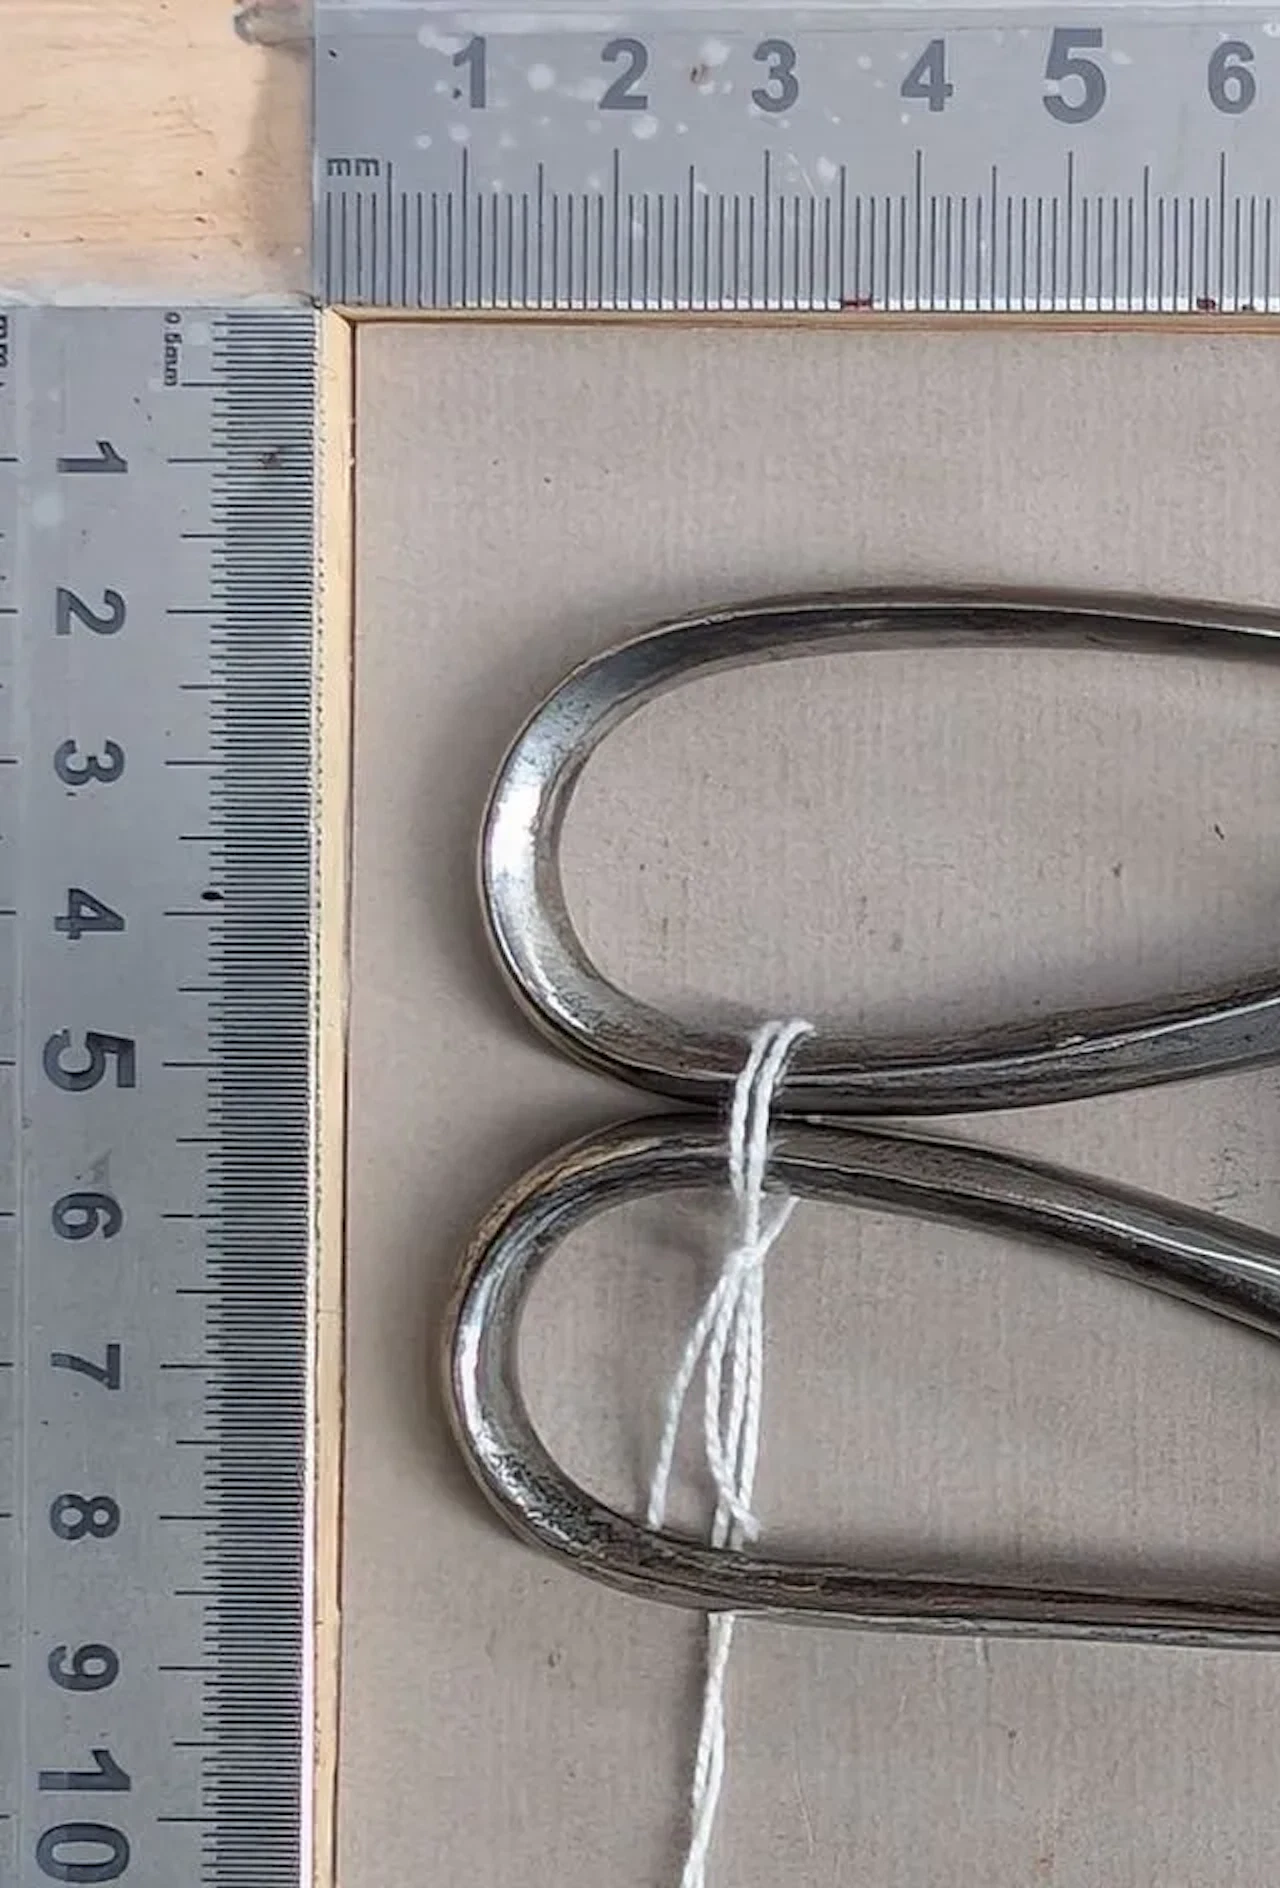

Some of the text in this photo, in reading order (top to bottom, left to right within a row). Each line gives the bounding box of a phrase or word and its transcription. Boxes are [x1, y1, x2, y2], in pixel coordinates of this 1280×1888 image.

[453, 36, 487, 108] 1
[600, 38, 648, 110] 2
[752, 39, 800, 112] 3
[901, 39, 953, 112] 4
[1043, 27, 1106, 124] 5
[1207, 41, 1256, 114] 6
[326, 157, 380, 177] mm
[35, 440, 136, 1884] 1 2 3 4 5 6 7 8 9 10
